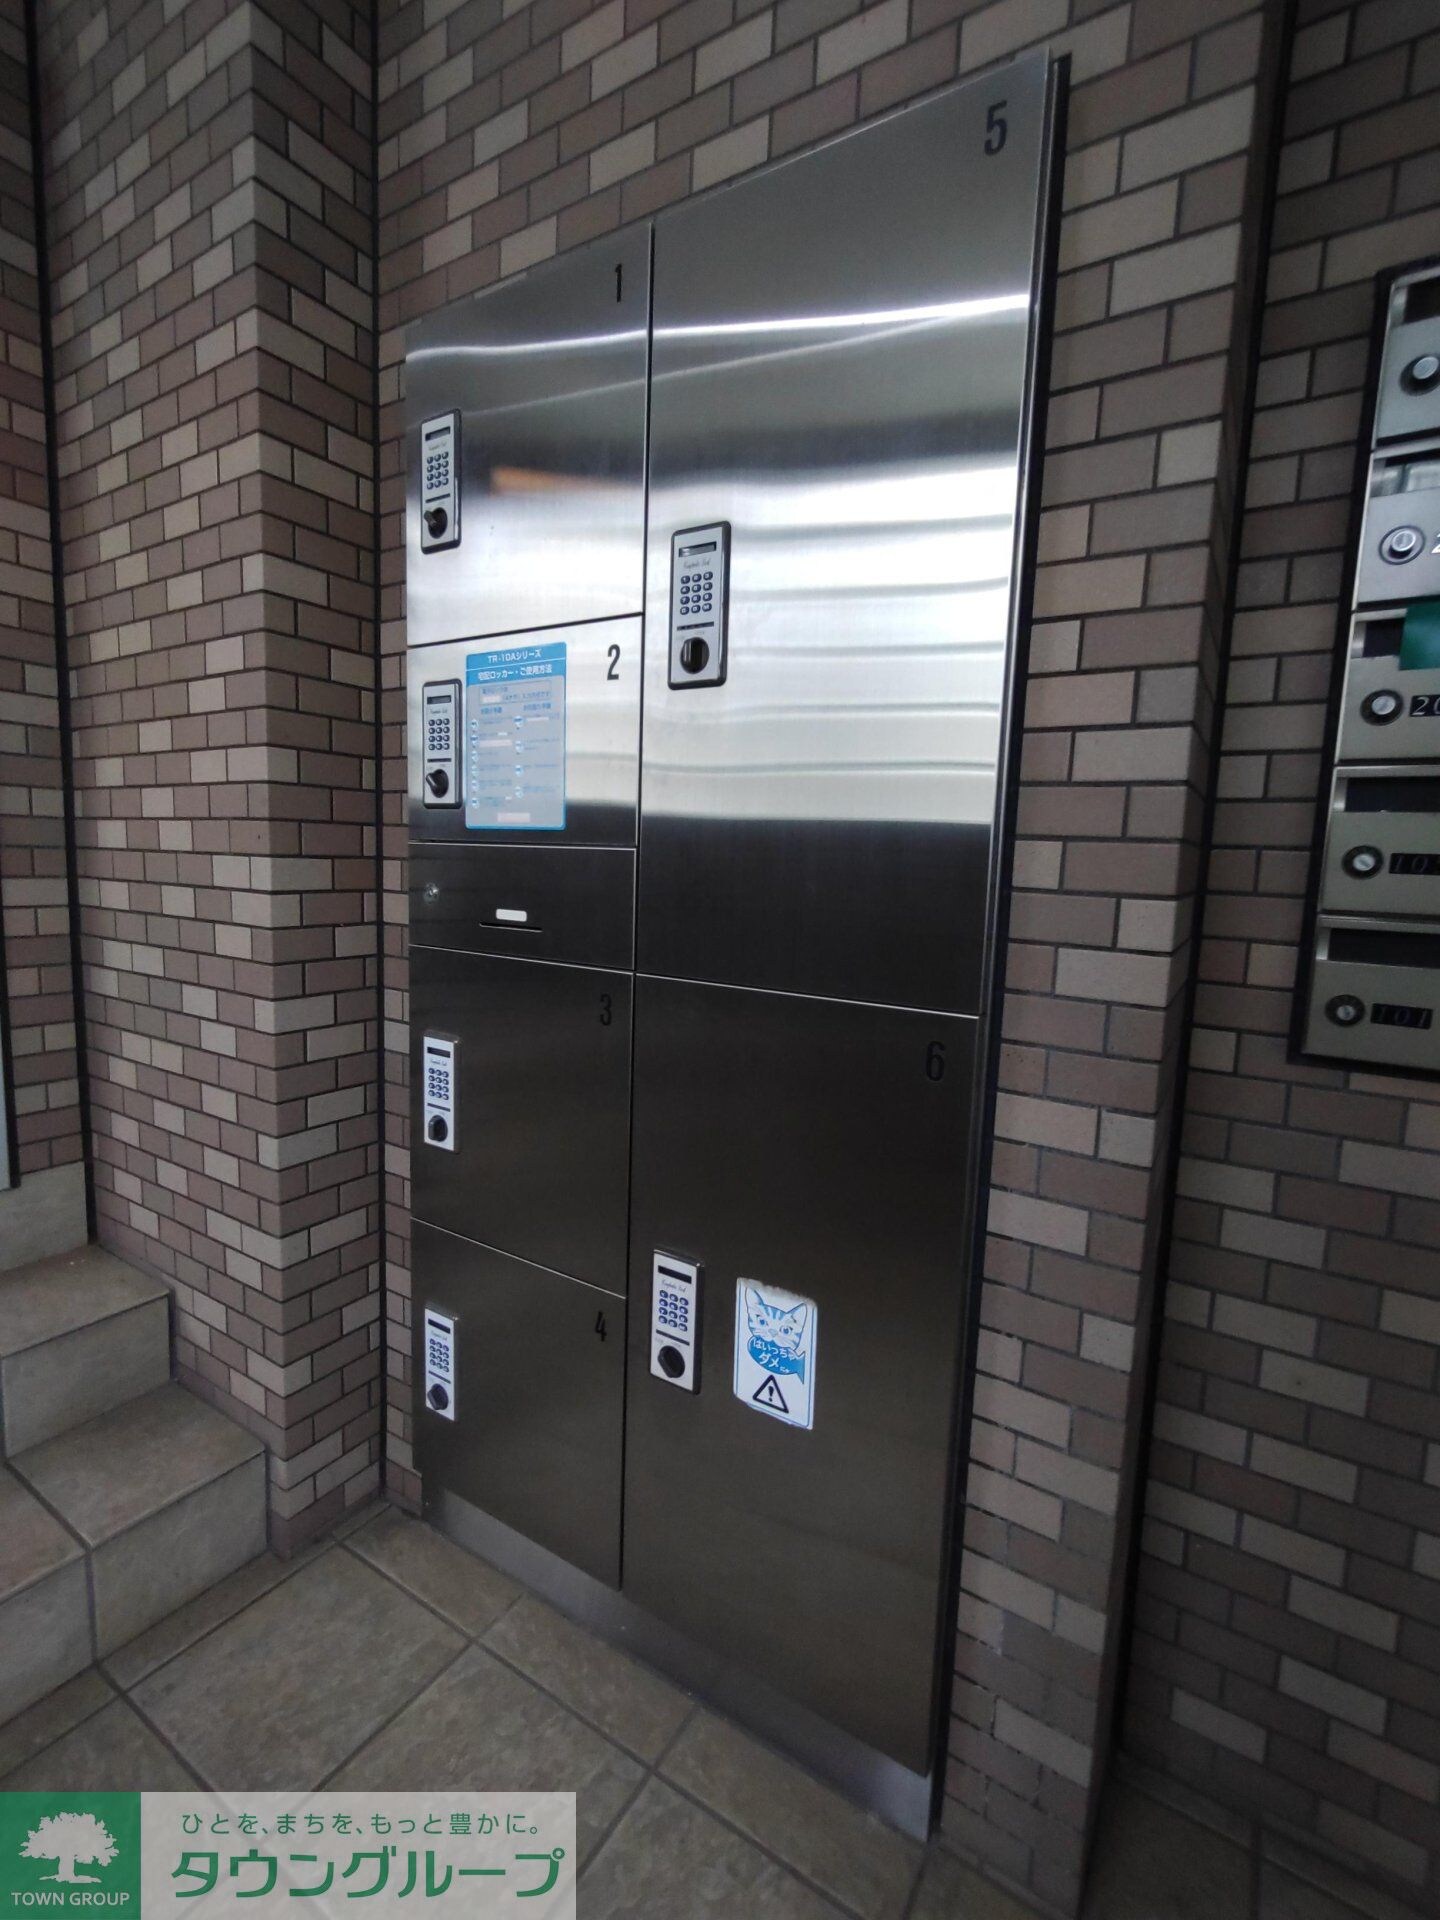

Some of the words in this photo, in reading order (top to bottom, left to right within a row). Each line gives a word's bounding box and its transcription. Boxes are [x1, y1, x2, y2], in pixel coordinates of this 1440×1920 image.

[984, 100, 1007, 155] 5
[615, 263, 622, 302] 1
[607, 644, 621, 681] 2
[600, 992, 612, 1026] 3
[926, 1040, 945, 1082] 6
[594, 1310, 607, 1343] 4
